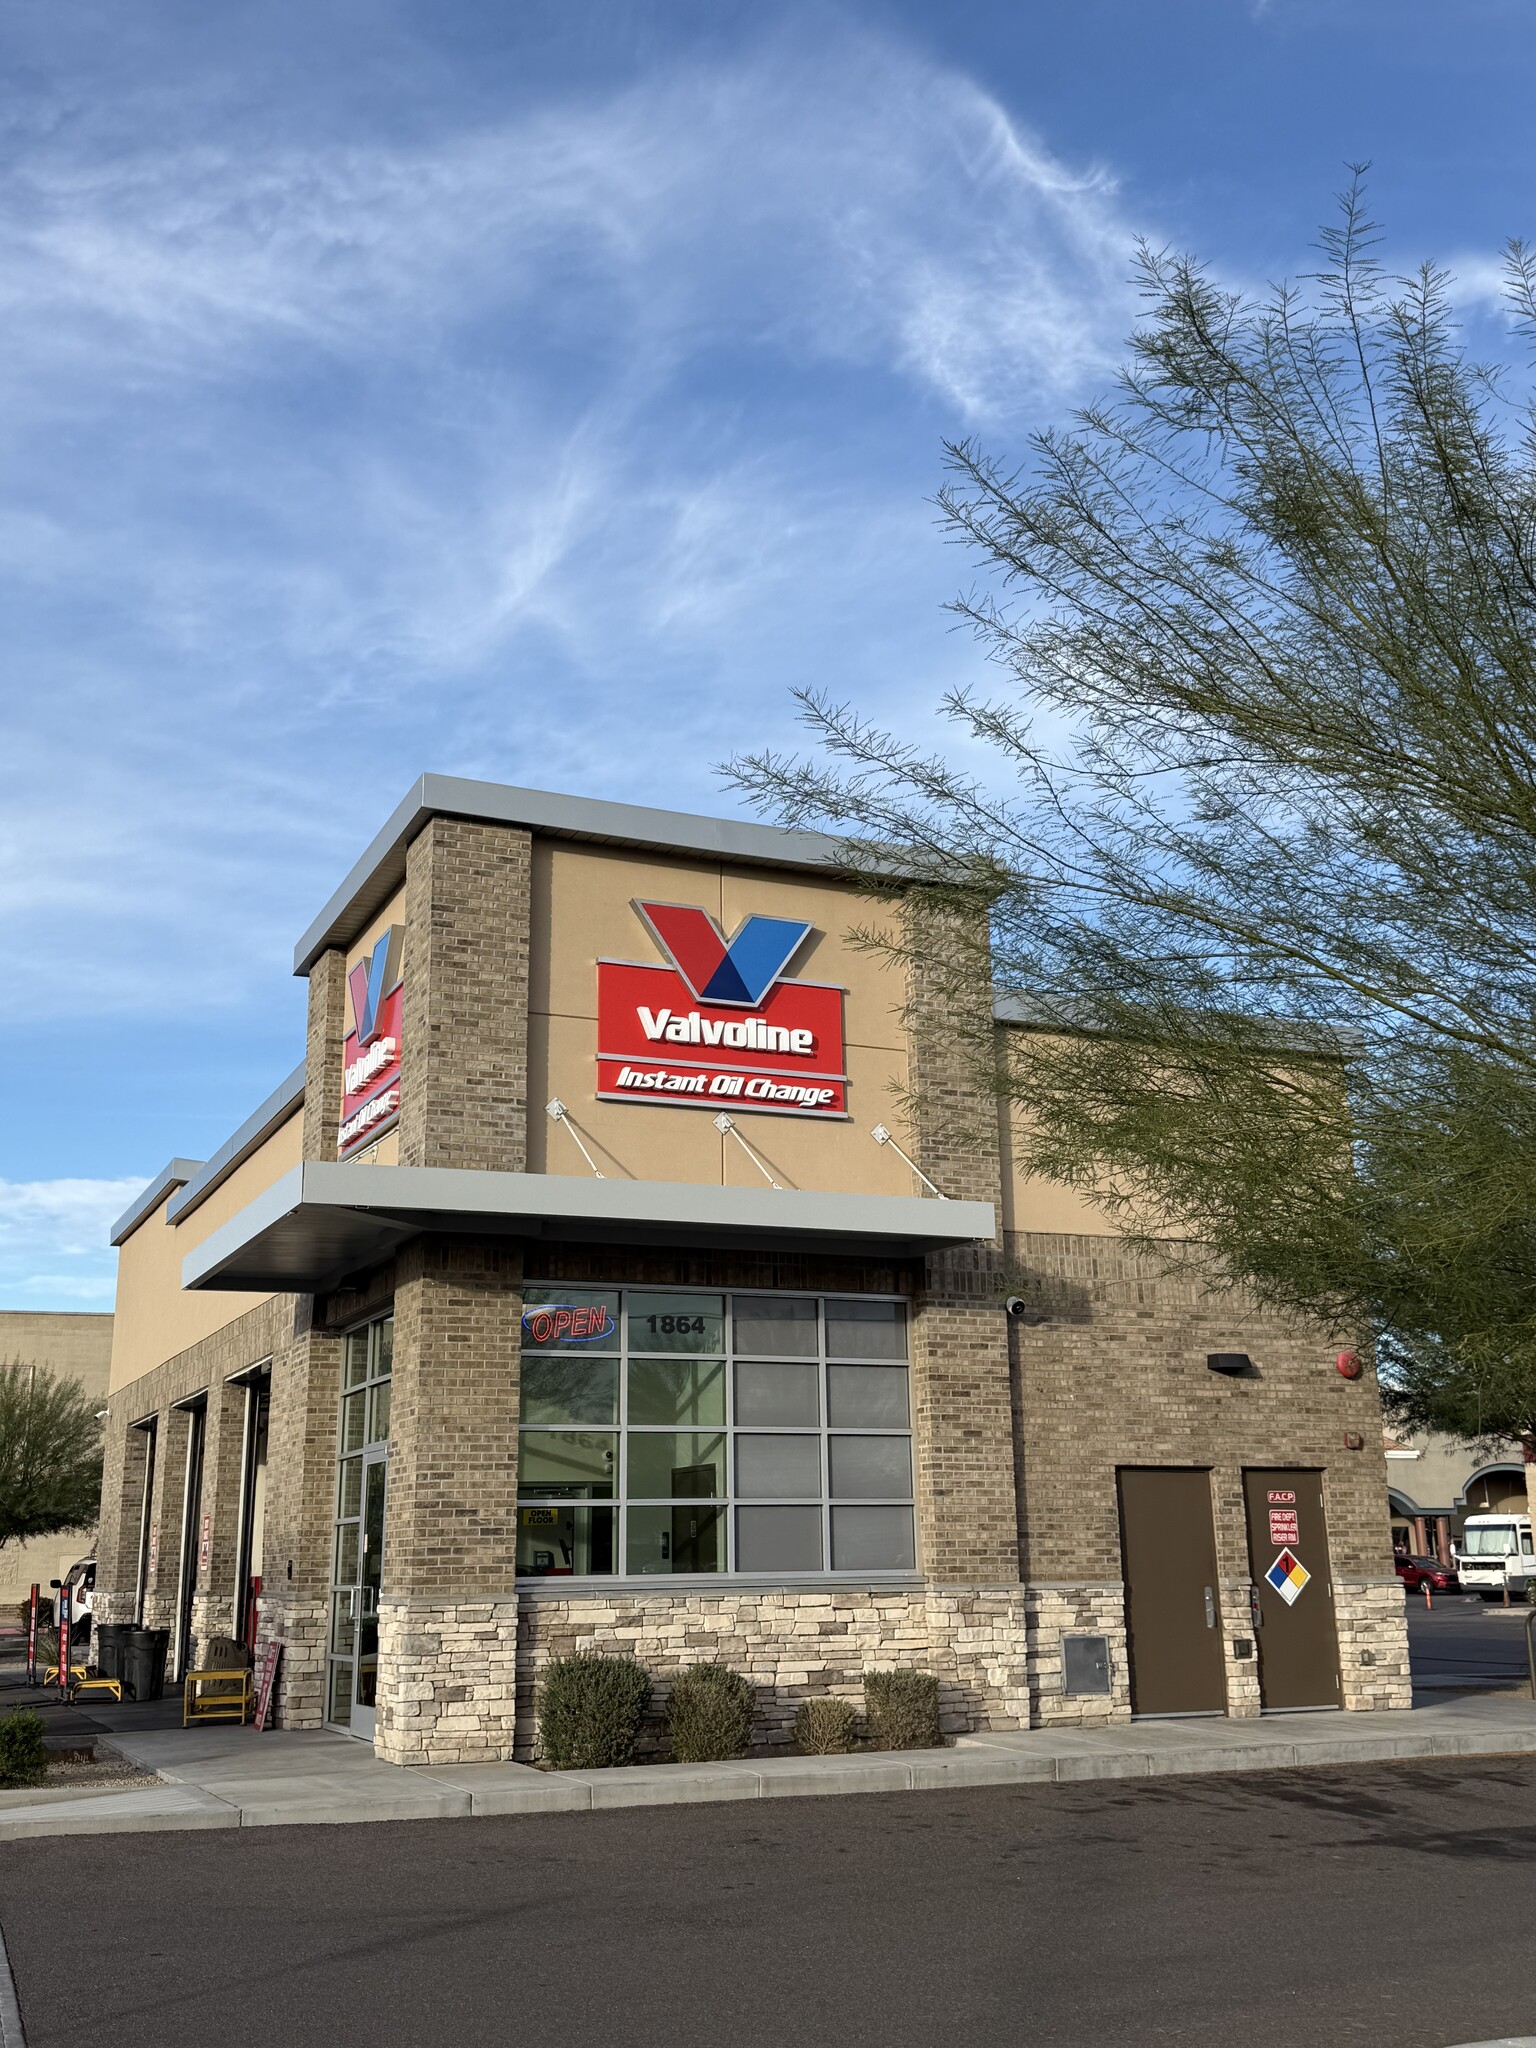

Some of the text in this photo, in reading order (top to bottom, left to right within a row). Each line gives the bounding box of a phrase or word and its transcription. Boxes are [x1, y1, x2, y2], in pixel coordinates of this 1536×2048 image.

[636, 1006, 814, 1054] Valvoline
[615, 1066, 835, 1107] Instant Oil Change
[531, 1305, 607, 1342] OPEN
[647, 1314, 706, 1335] 1864
[528, 1516, 554, 1524] FLOOR
[530, 1509, 552, 1518] OPEN
[1271, 1522, 1297, 1532] SPRINKLER
[1282, 1555, 1289, 1573] 1
